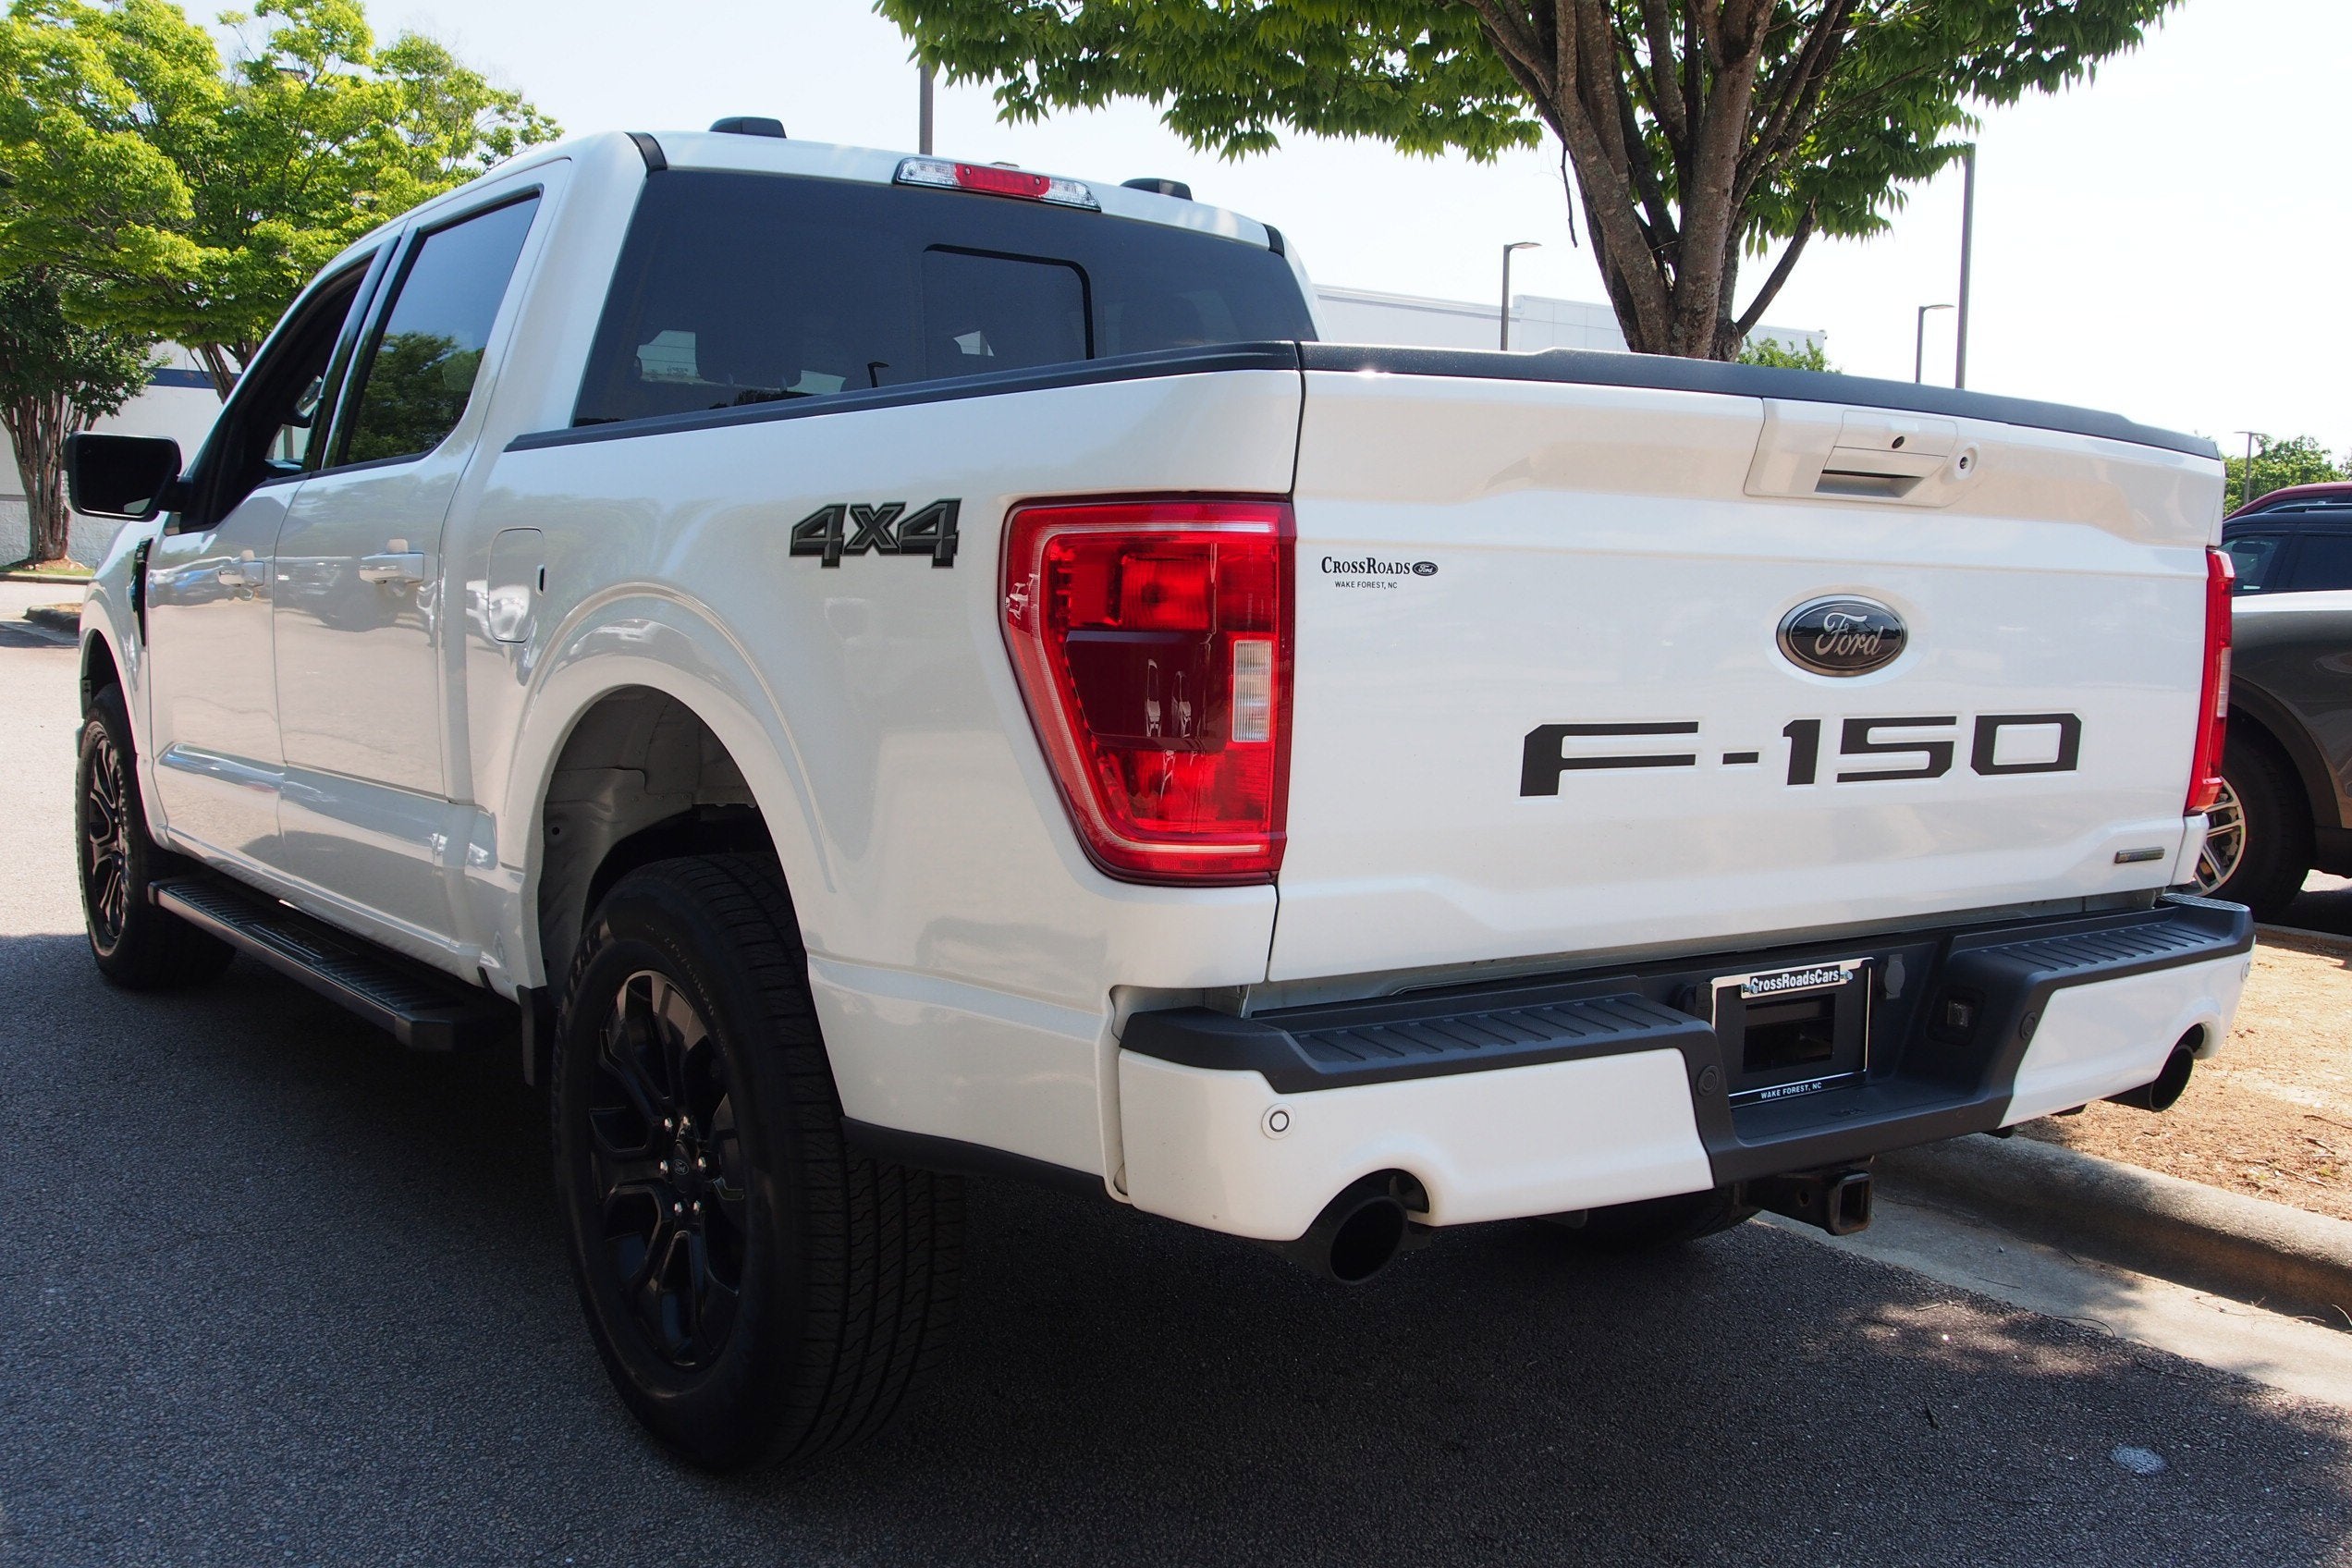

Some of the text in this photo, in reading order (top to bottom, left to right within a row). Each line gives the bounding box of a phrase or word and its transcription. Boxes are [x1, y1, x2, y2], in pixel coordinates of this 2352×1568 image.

[1357, 581, 1387, 590] FOREST,
[1815, 612, 1884, 655] Ford
[1520, 713, 2082, 796] F-150
[1749, 969, 1840, 993] CrossRoadsCars
[1760, 1082, 1822, 1099] WAKE FOREST, NC
